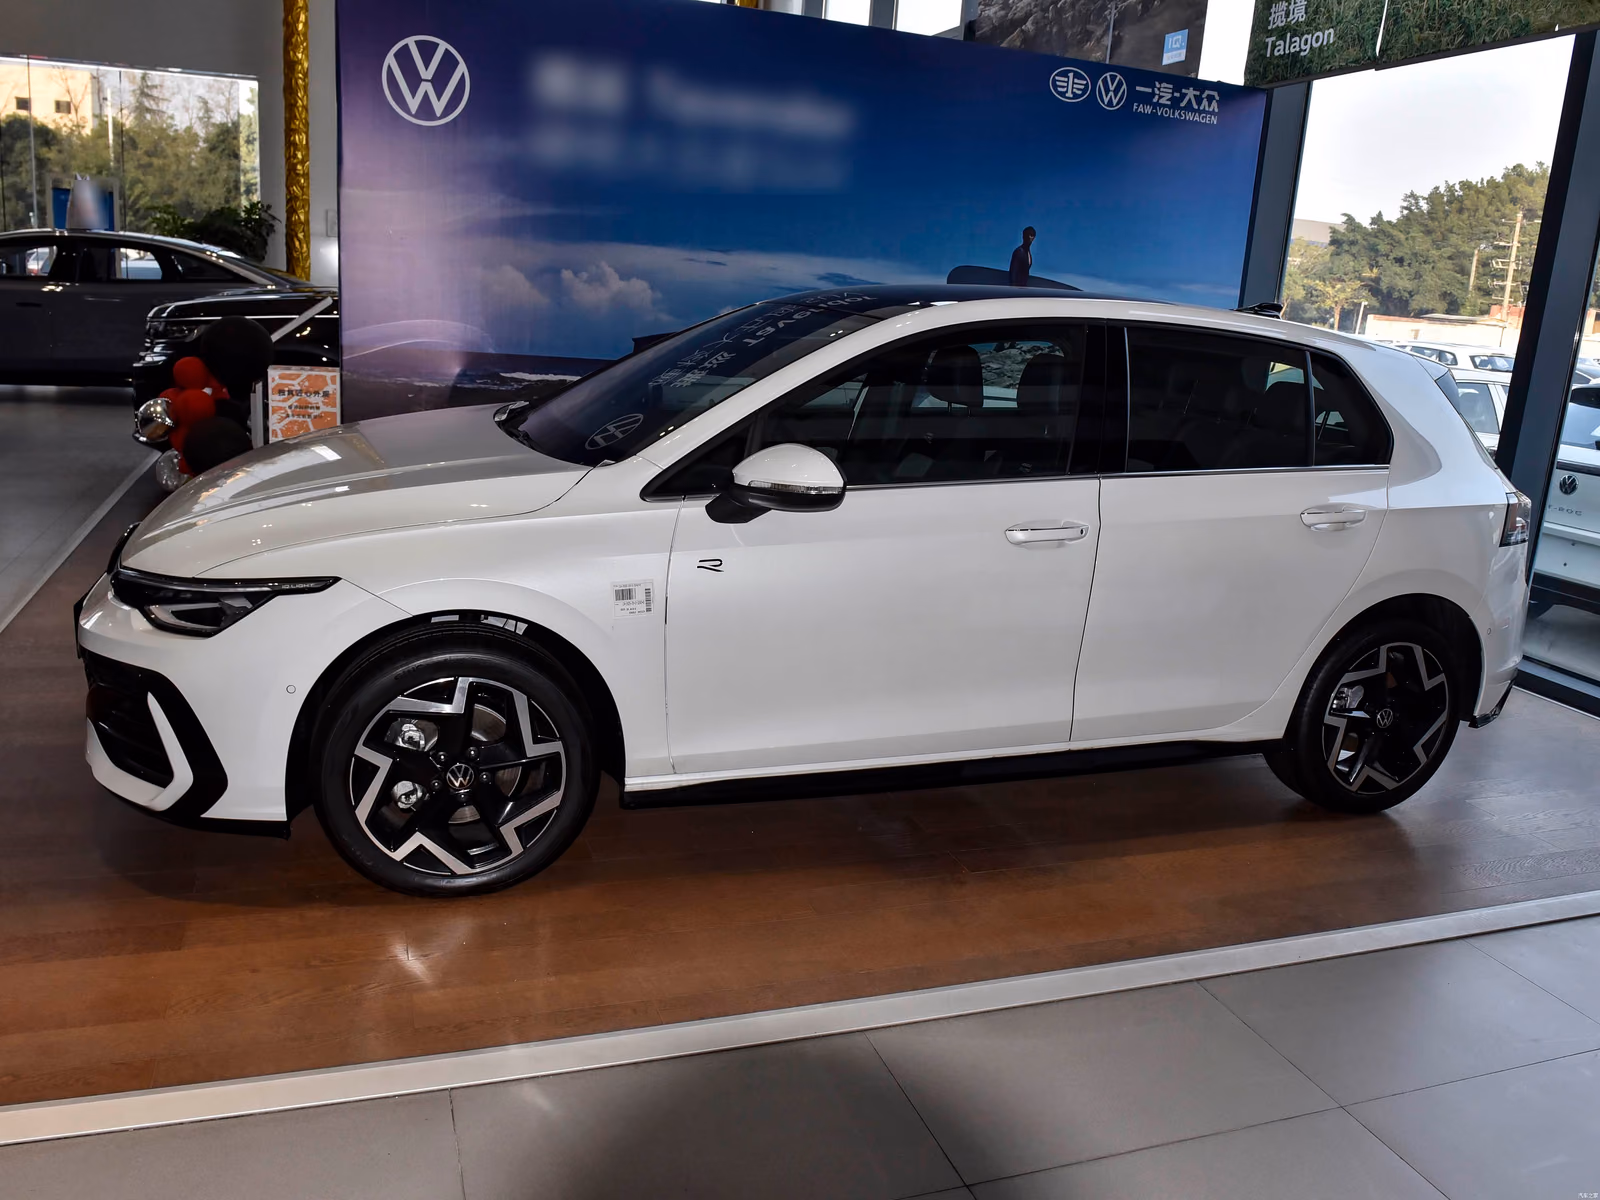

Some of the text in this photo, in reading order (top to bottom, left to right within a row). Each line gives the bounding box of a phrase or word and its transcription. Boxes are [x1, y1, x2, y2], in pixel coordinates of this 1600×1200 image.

[1267, 0, 1307, 30] 揽境
[1265, 28, 1334, 58] Talagon
[382, 35, 470, 126] VW
[1096, 72, 1127, 110] VW
[1133, 103, 1218, 125] FAW-VOLKSWAGEN
[446, 763, 475, 790] VW
